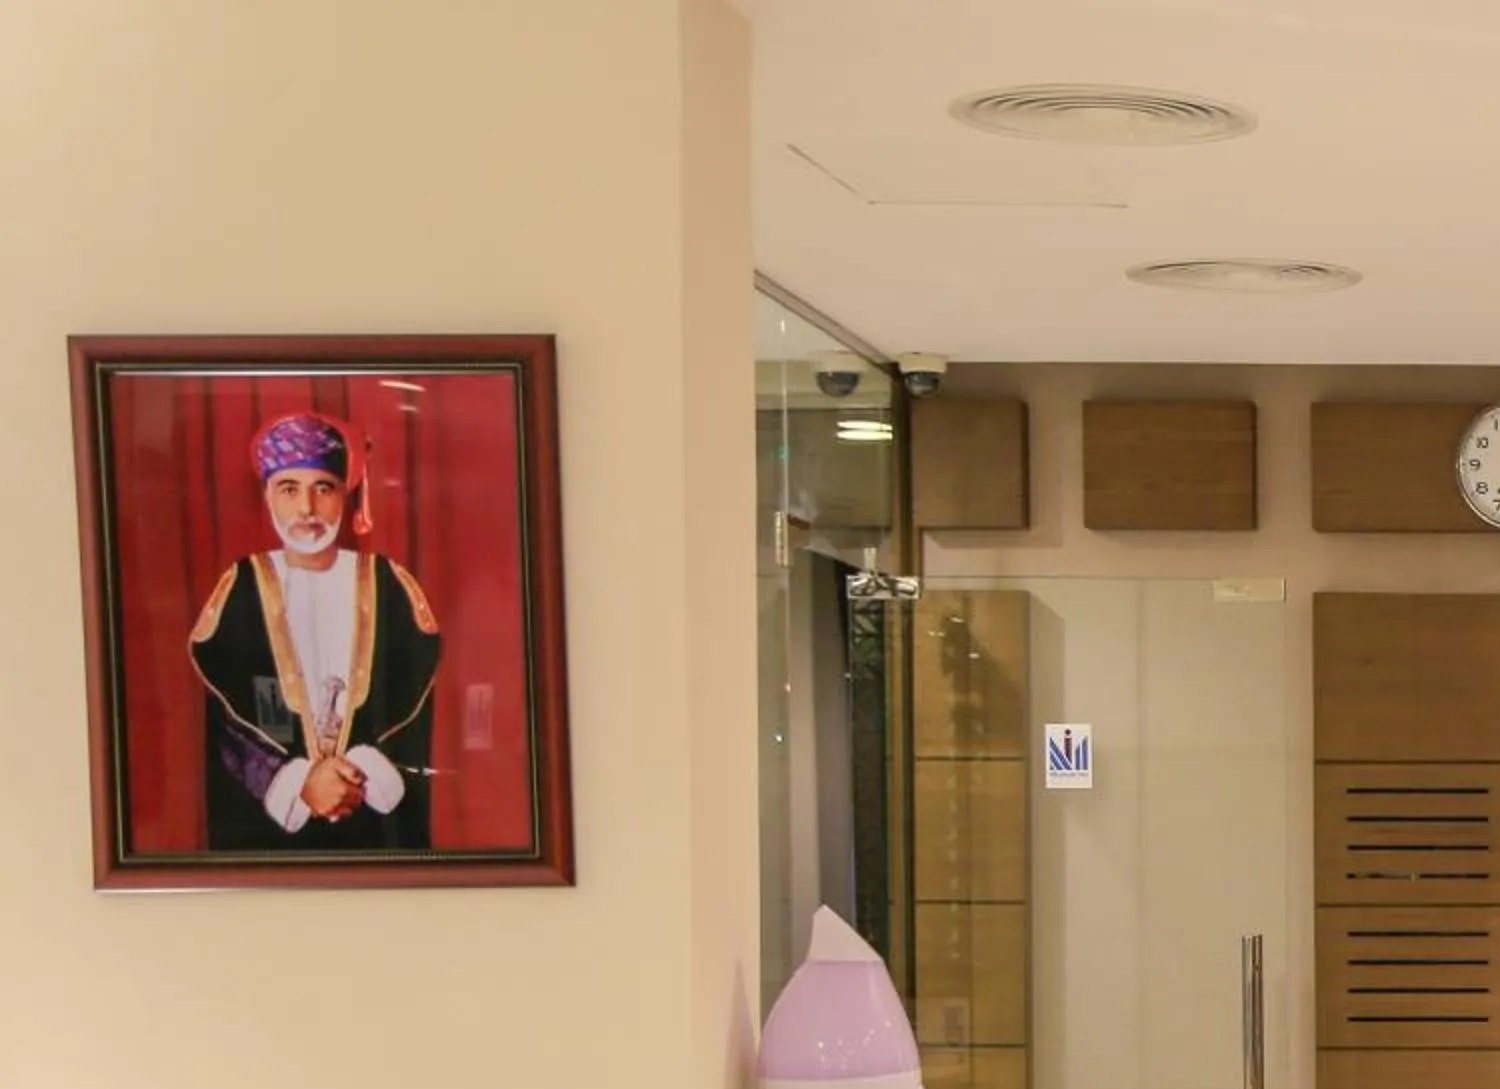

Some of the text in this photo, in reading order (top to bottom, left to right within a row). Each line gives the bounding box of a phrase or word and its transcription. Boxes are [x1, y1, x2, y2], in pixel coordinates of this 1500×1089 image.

[1477, 437, 1489, 449] 10
[1469, 458, 1481, 471] 9
[1476, 481, 1489, 495] 8
